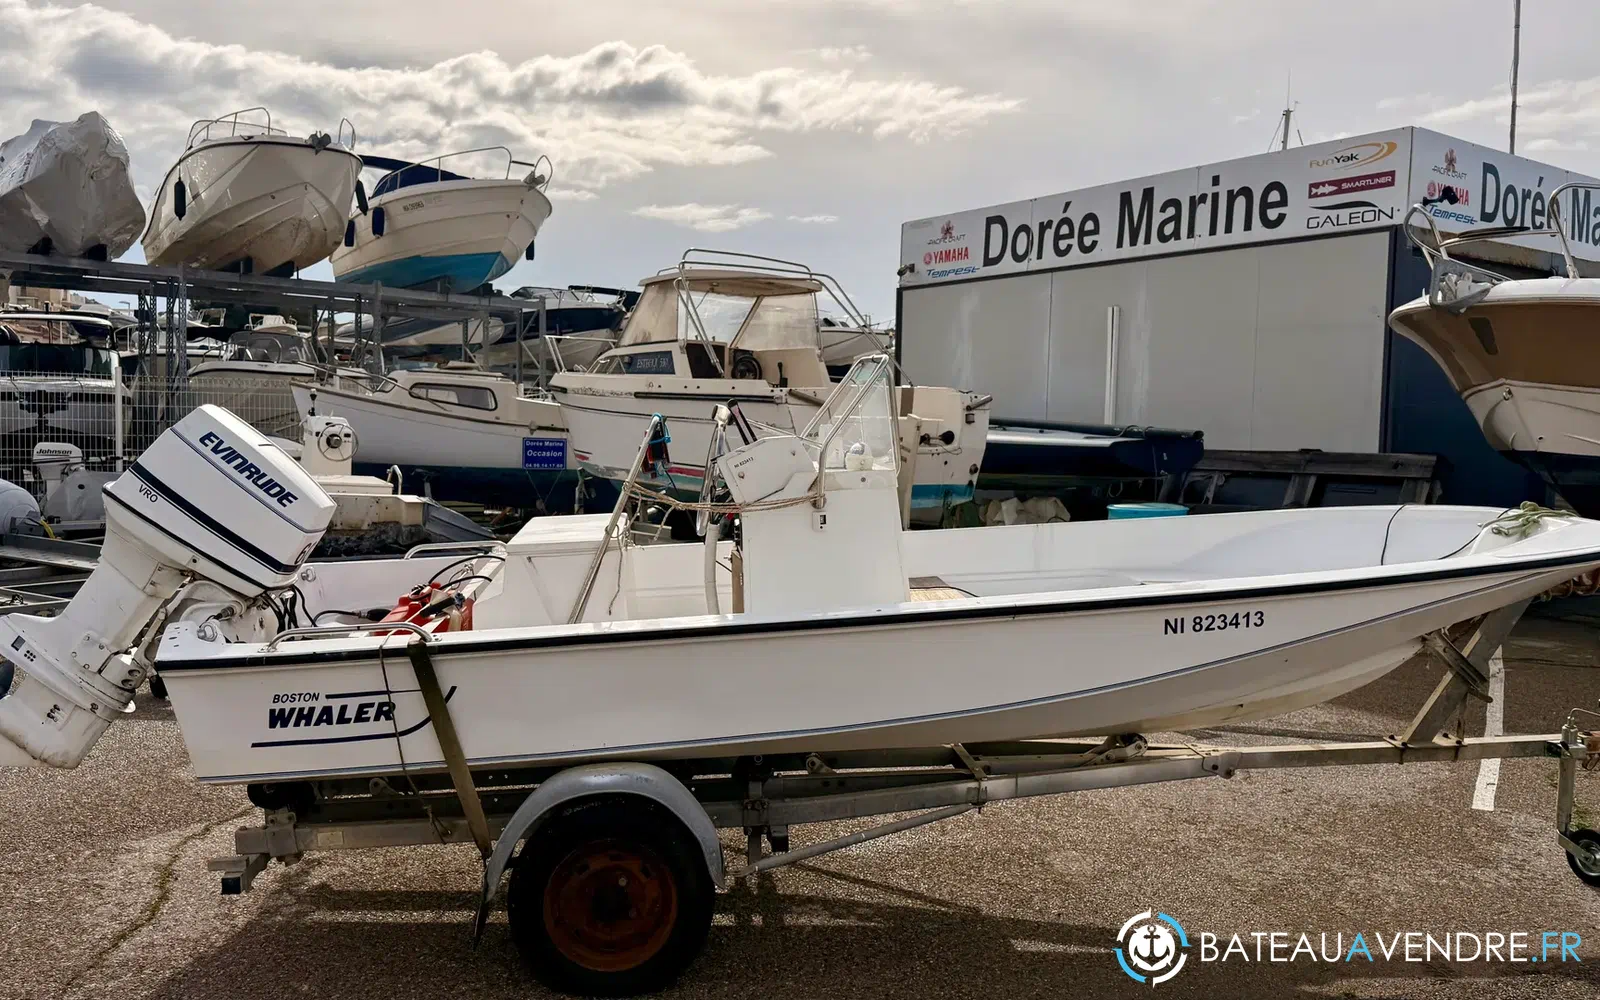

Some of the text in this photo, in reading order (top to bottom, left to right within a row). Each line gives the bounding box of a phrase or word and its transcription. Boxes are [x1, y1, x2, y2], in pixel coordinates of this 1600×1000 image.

[1341, 175, 1392, 190] SMARTLINER
[982, 174, 1289, 268] Dorée Marine
[1306, 206, 1394, 230] GALEON
[933, 246, 969, 265] YAMAHA
[526, 449, 563, 457] Occasion
[198, 430, 299, 508] EVINRUDE
[138, 484, 158, 503] VRO
[1164, 610, 1265, 635] NI 823413
[272, 692, 320, 704] BOSTON
[268, 701, 397, 729] WHALER
